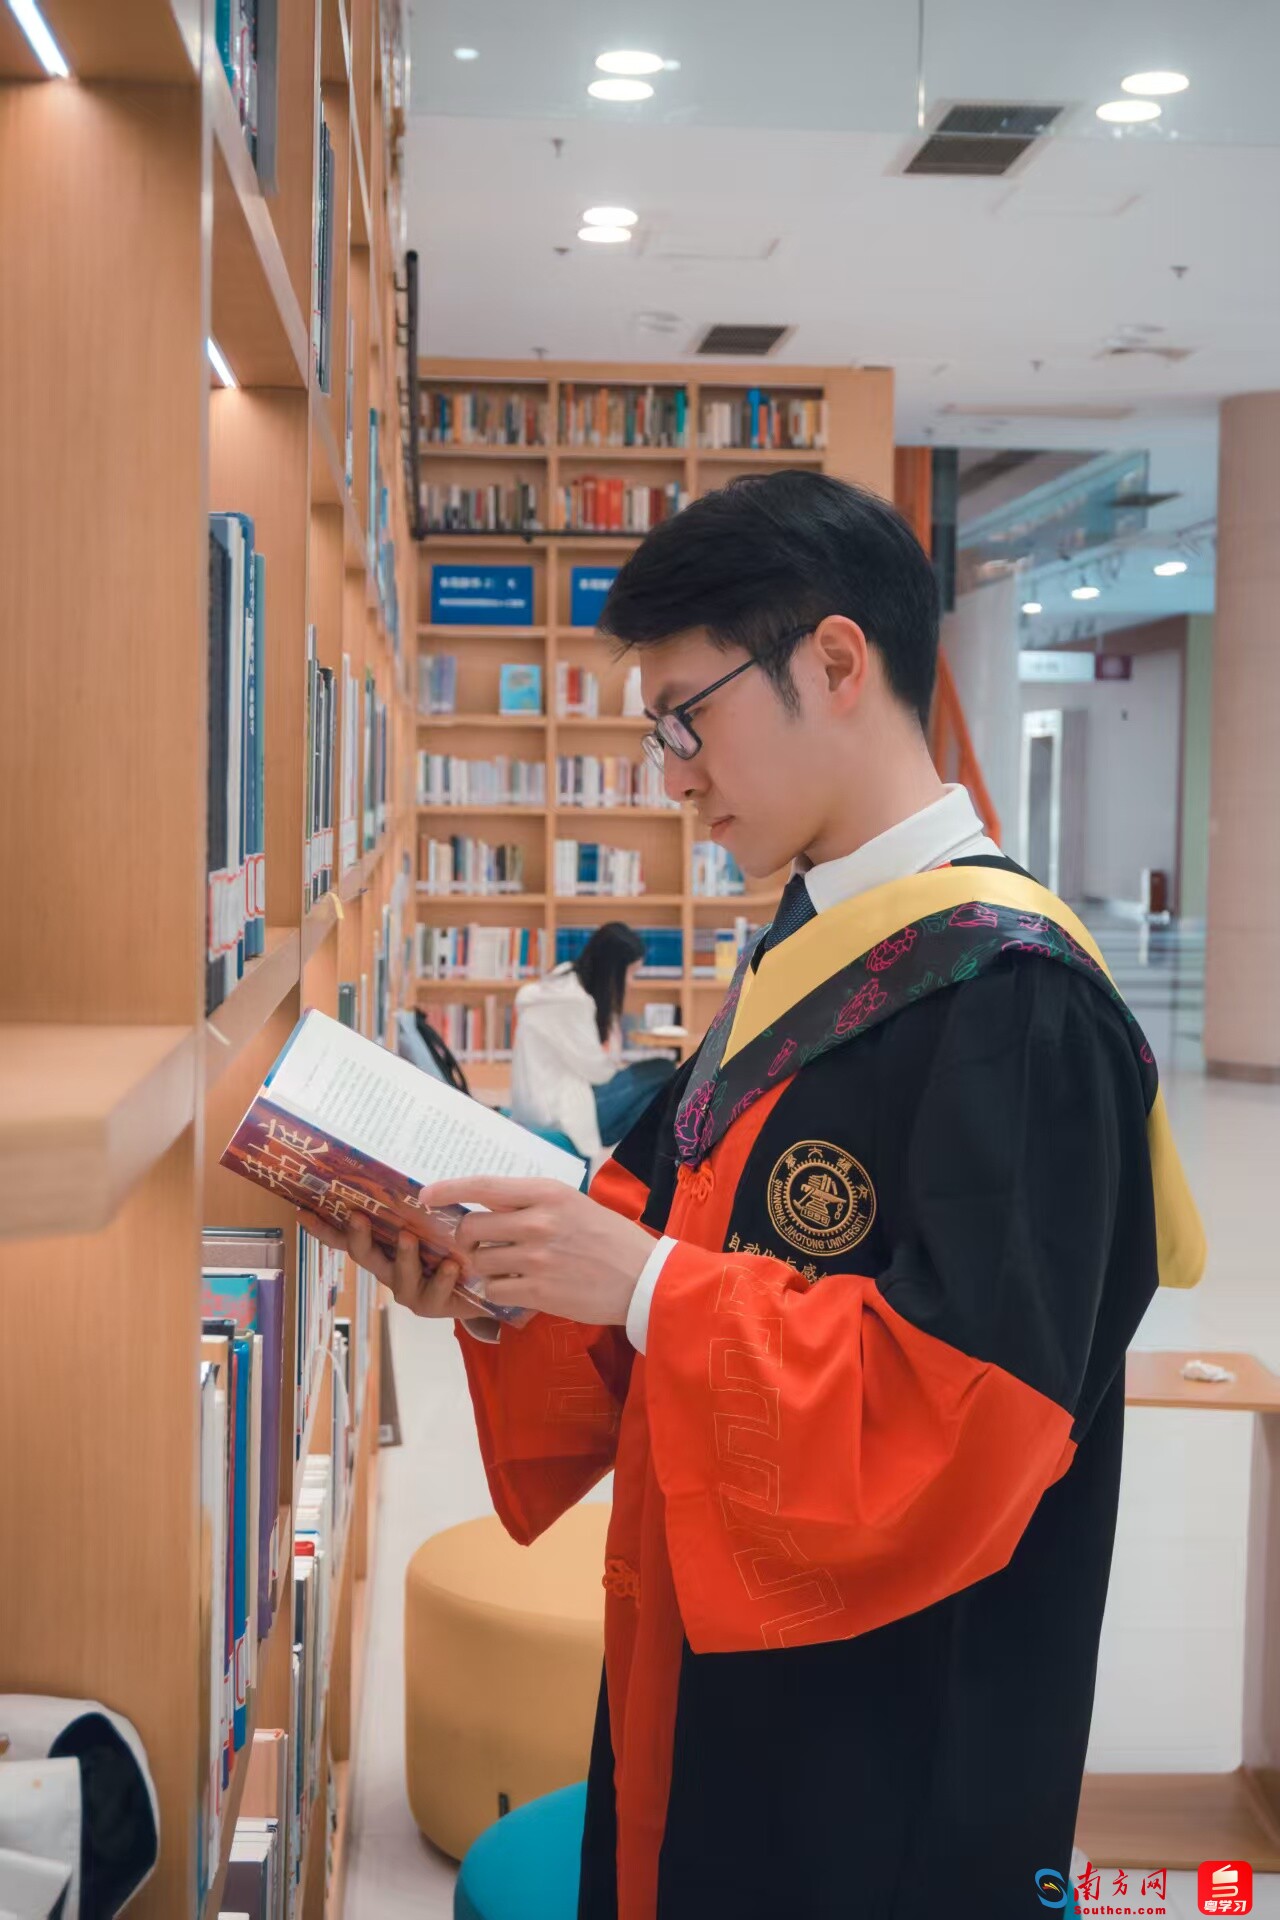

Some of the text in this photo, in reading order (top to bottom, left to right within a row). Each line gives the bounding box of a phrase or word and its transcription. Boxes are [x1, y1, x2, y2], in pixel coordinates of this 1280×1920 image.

[240, 1119, 329, 1199] 拜占庭
[772, 1178, 868, 1250] SHANGHAI JIAOTONG UNIVERSITY
